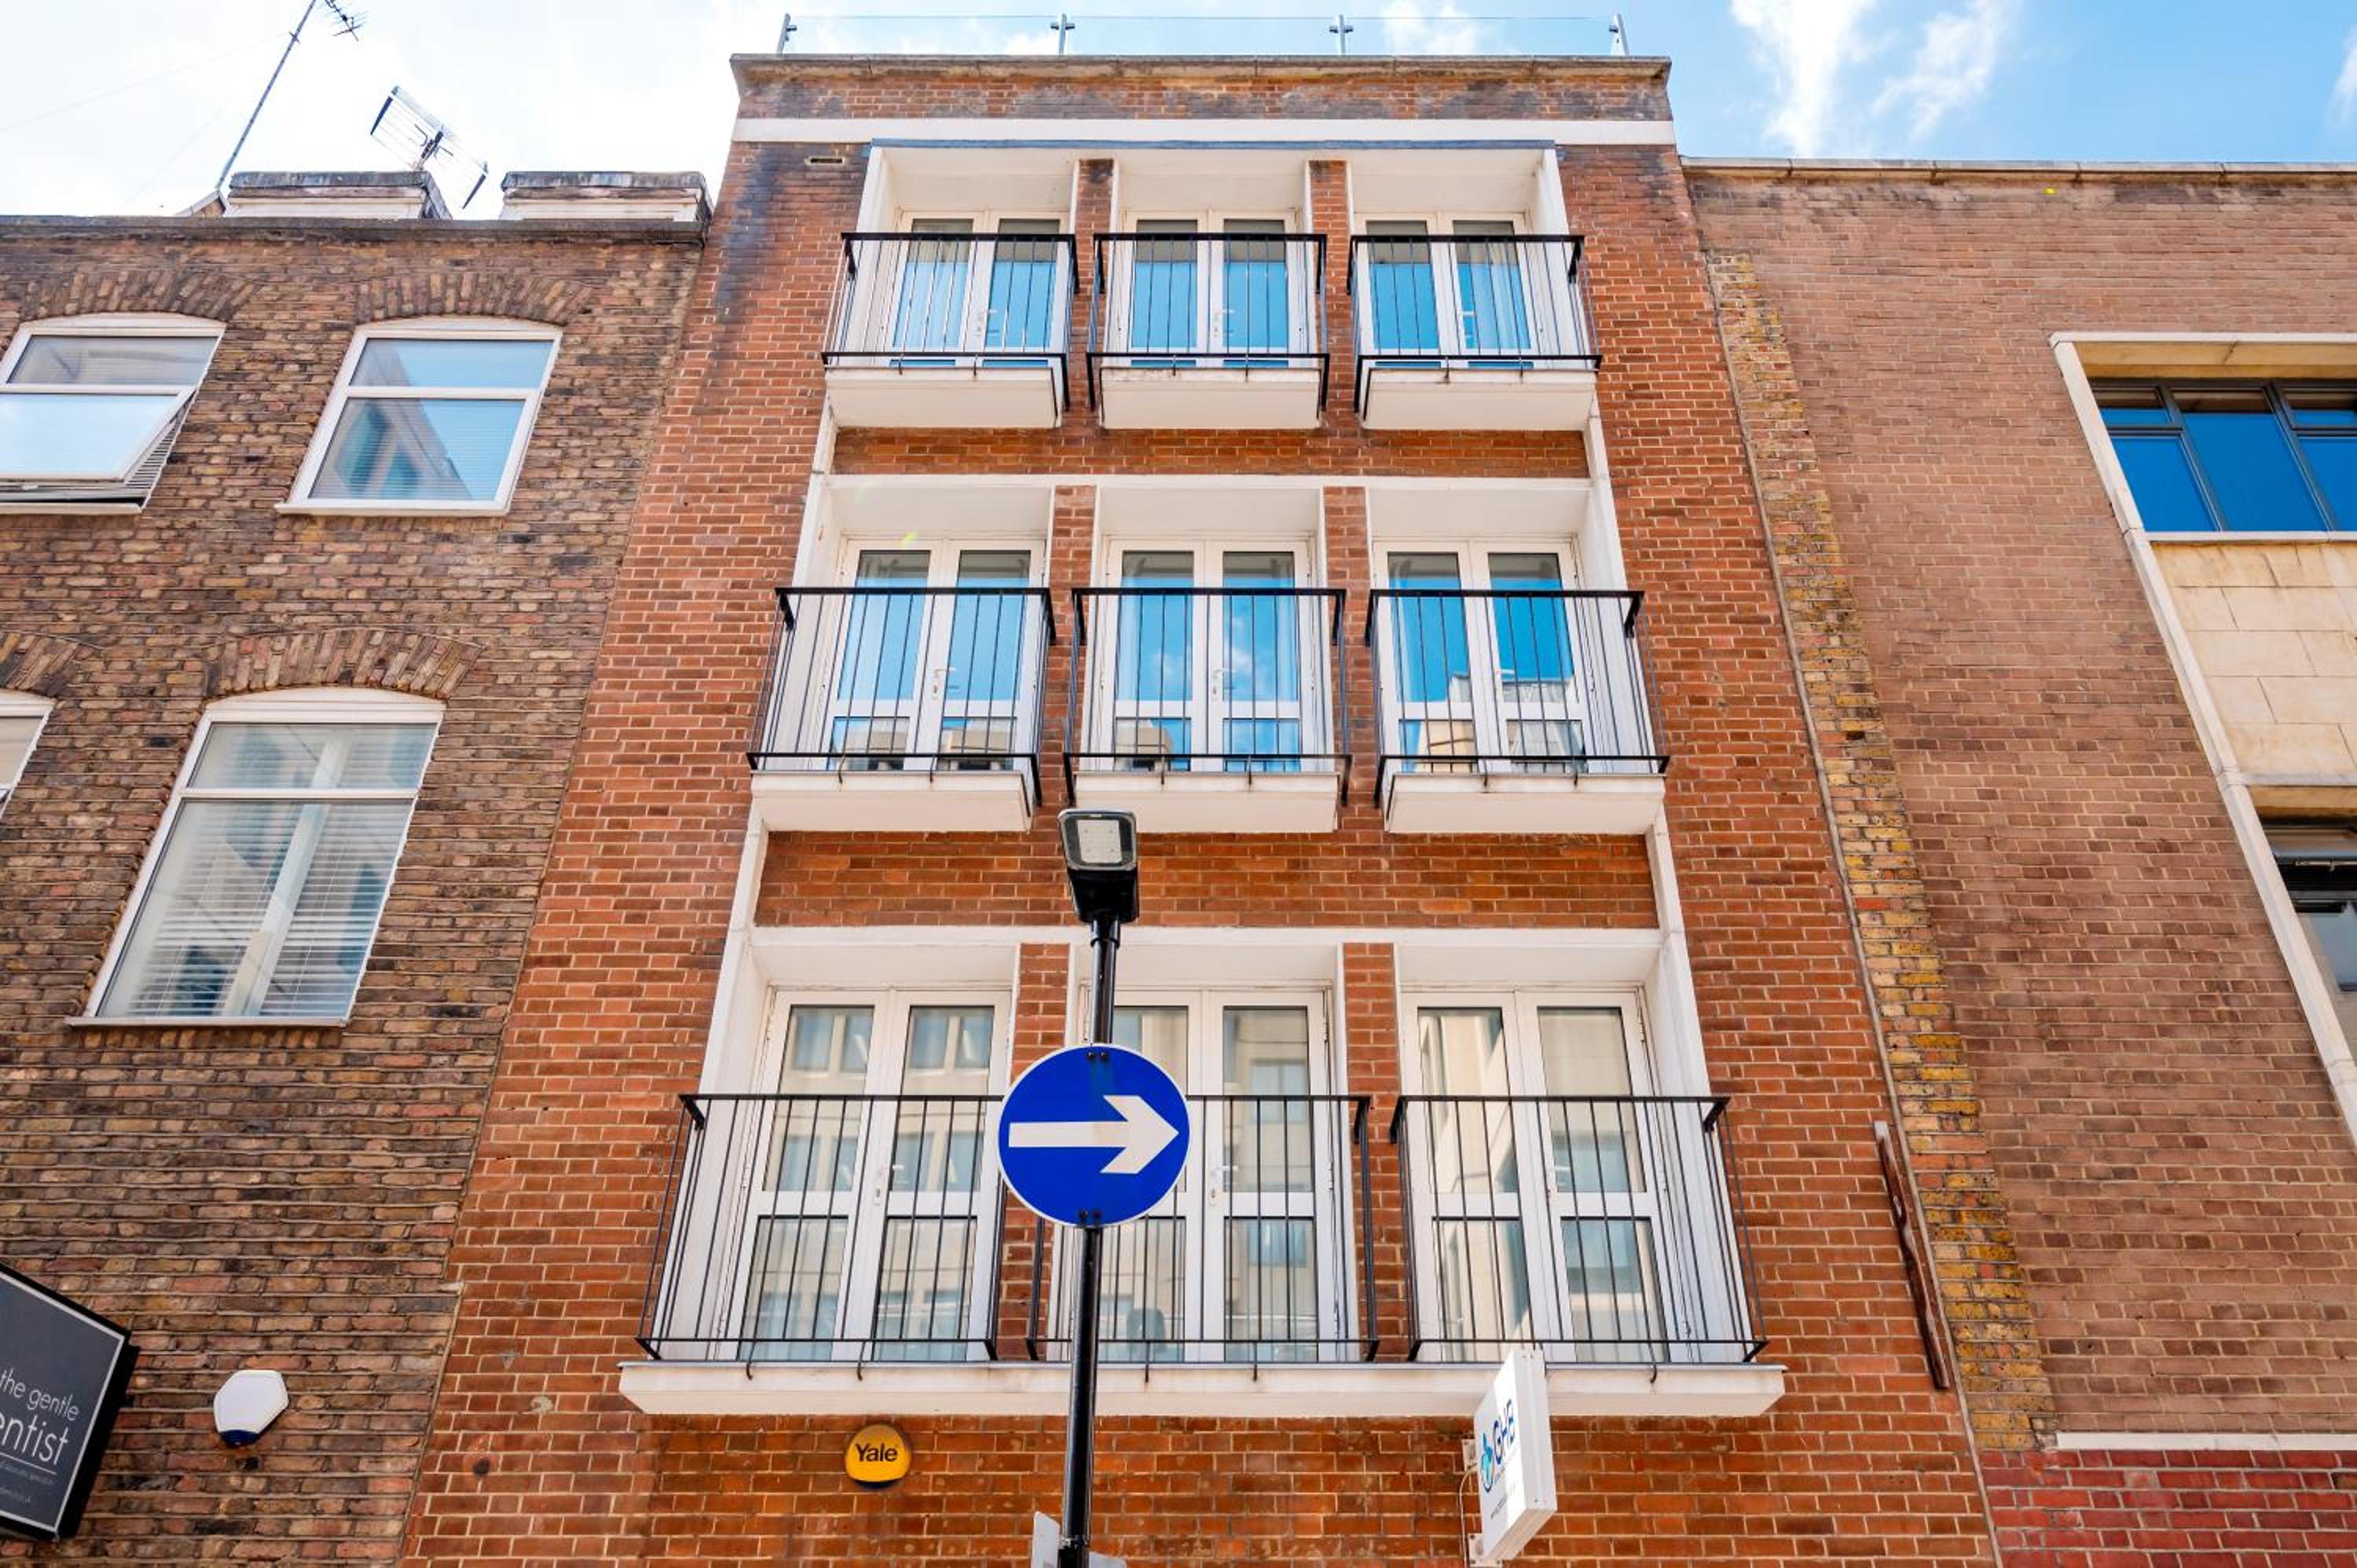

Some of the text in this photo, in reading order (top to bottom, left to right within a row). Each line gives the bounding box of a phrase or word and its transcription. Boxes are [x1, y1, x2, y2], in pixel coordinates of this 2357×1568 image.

[2, 1368, 79, 1421] the gentle
[855, 1442, 898, 1462] Yale
